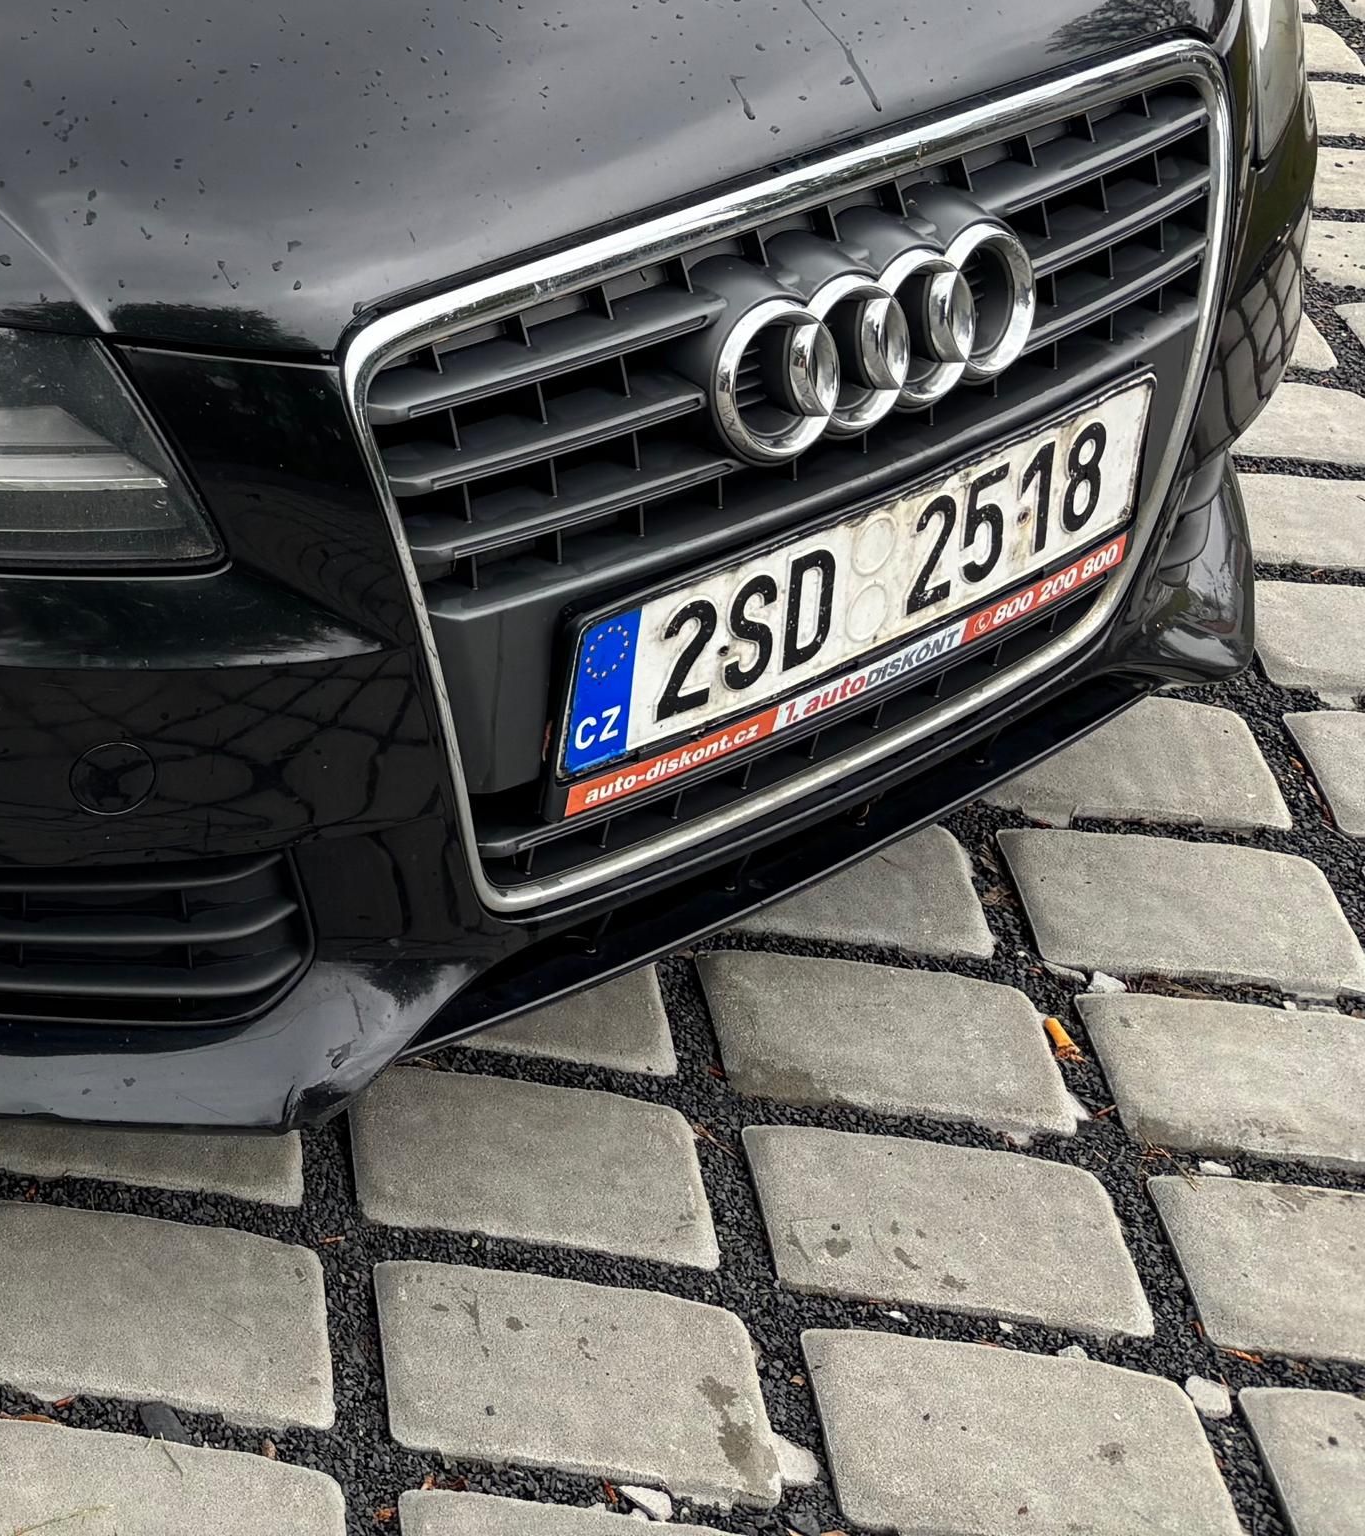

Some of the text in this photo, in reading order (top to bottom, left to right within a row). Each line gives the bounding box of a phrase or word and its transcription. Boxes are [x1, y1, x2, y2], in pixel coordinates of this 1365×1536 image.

[655, 421, 1107, 723] 2SD 2518
[992, 544, 1118, 625] 800 200 800
[574, 705, 622, 750] CZ
[584, 724, 759, 805] auto-diskont.cz
